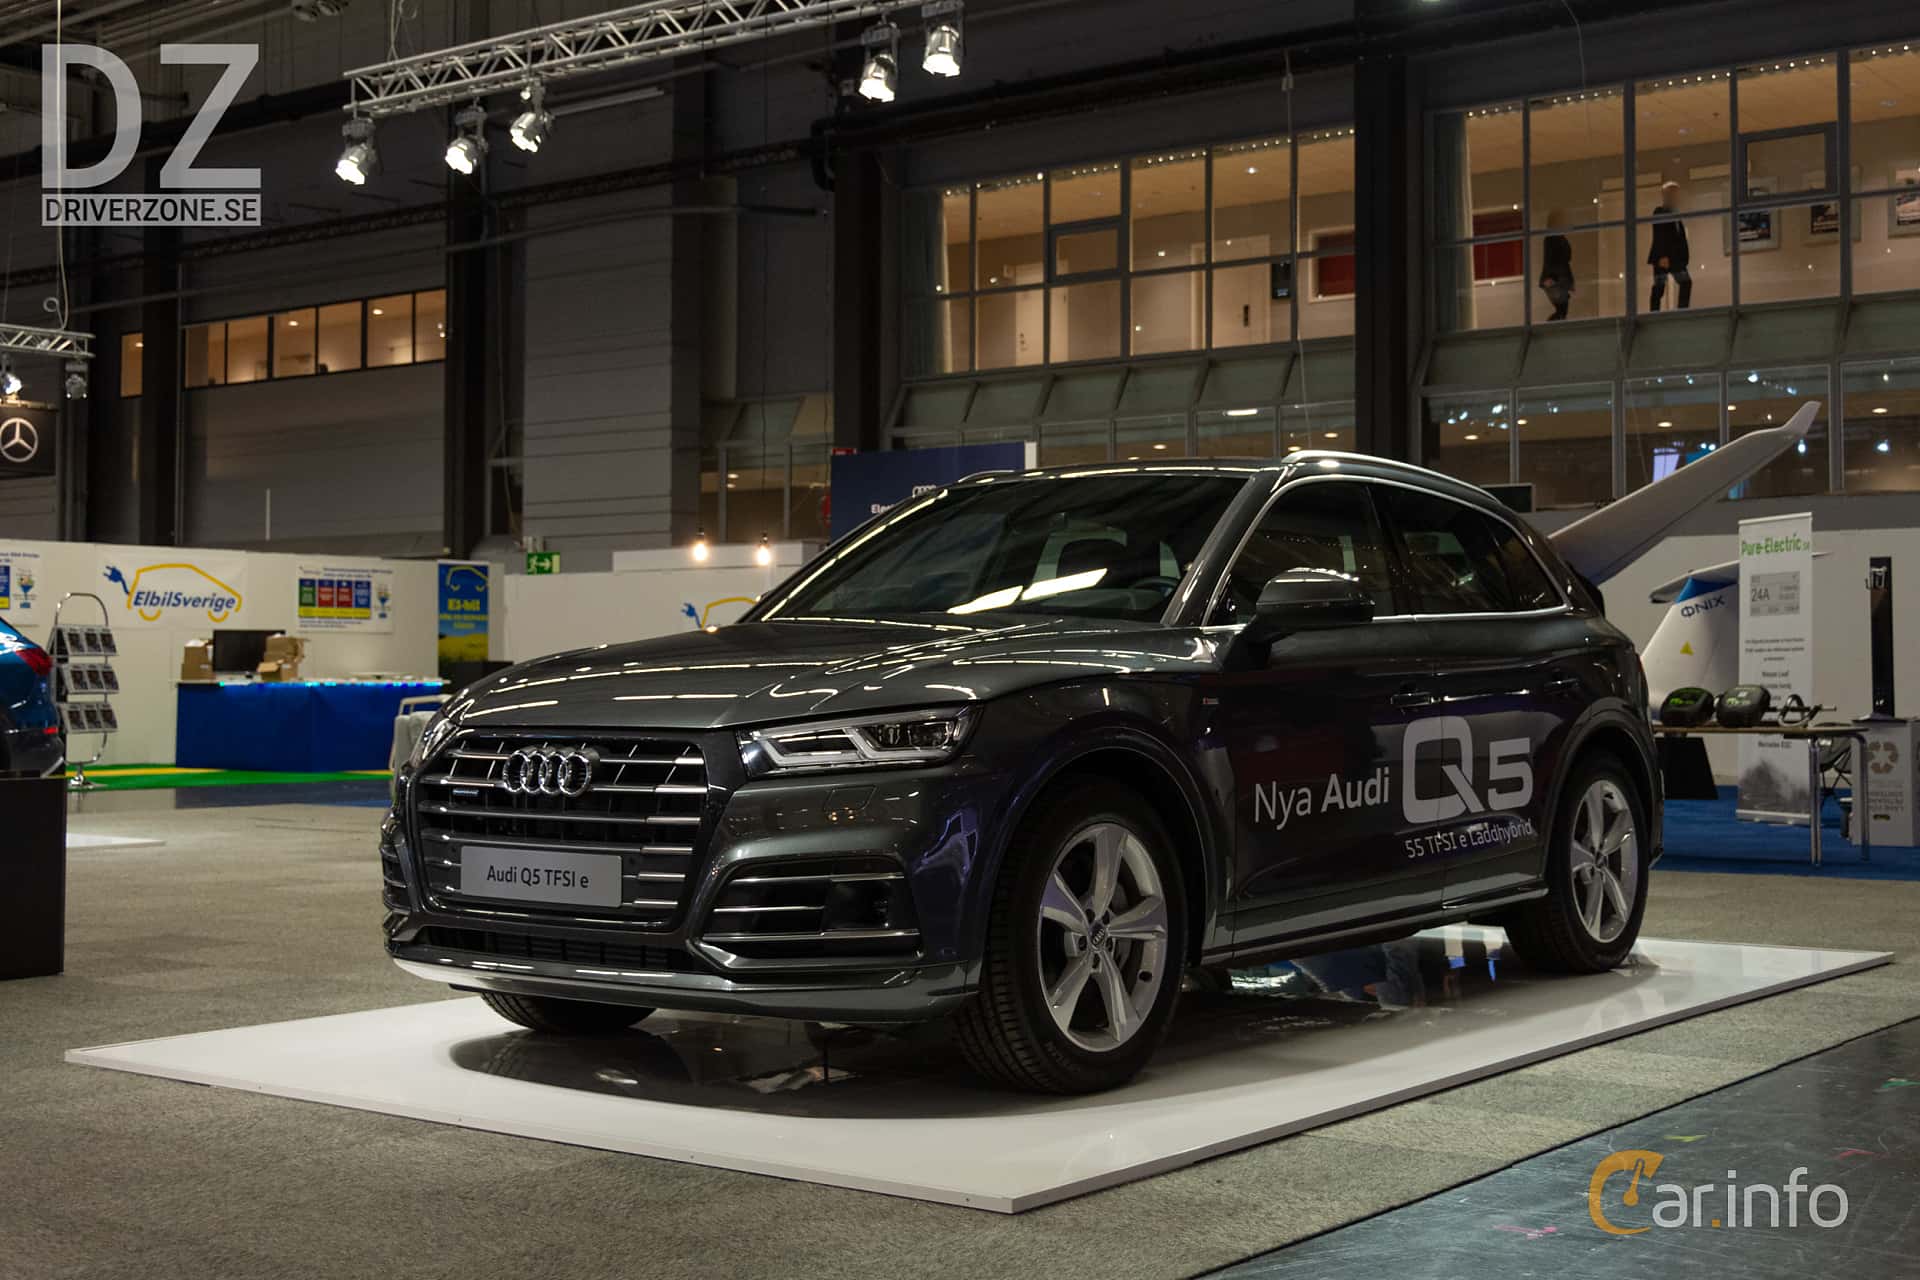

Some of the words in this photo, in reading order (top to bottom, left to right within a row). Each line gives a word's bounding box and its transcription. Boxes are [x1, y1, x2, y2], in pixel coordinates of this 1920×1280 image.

[133, 590, 236, 612] ElbilSverige
[1254, 780, 1312, 831] Nya
[1320, 766, 1390, 813] Audi
[1402, 715, 1534, 824] Q5
[1404, 837, 1425, 859] 55
[1424, 832, 1458, 855] TFSI
[1459, 834, 1468, 848] e
[1469, 818, 1533, 846] Laddhybrid
[486, 864, 518, 883] Audi
[520, 867, 541, 887] Q5
[544, 868, 576, 888] TFSI
[580, 875, 589, 889] e
